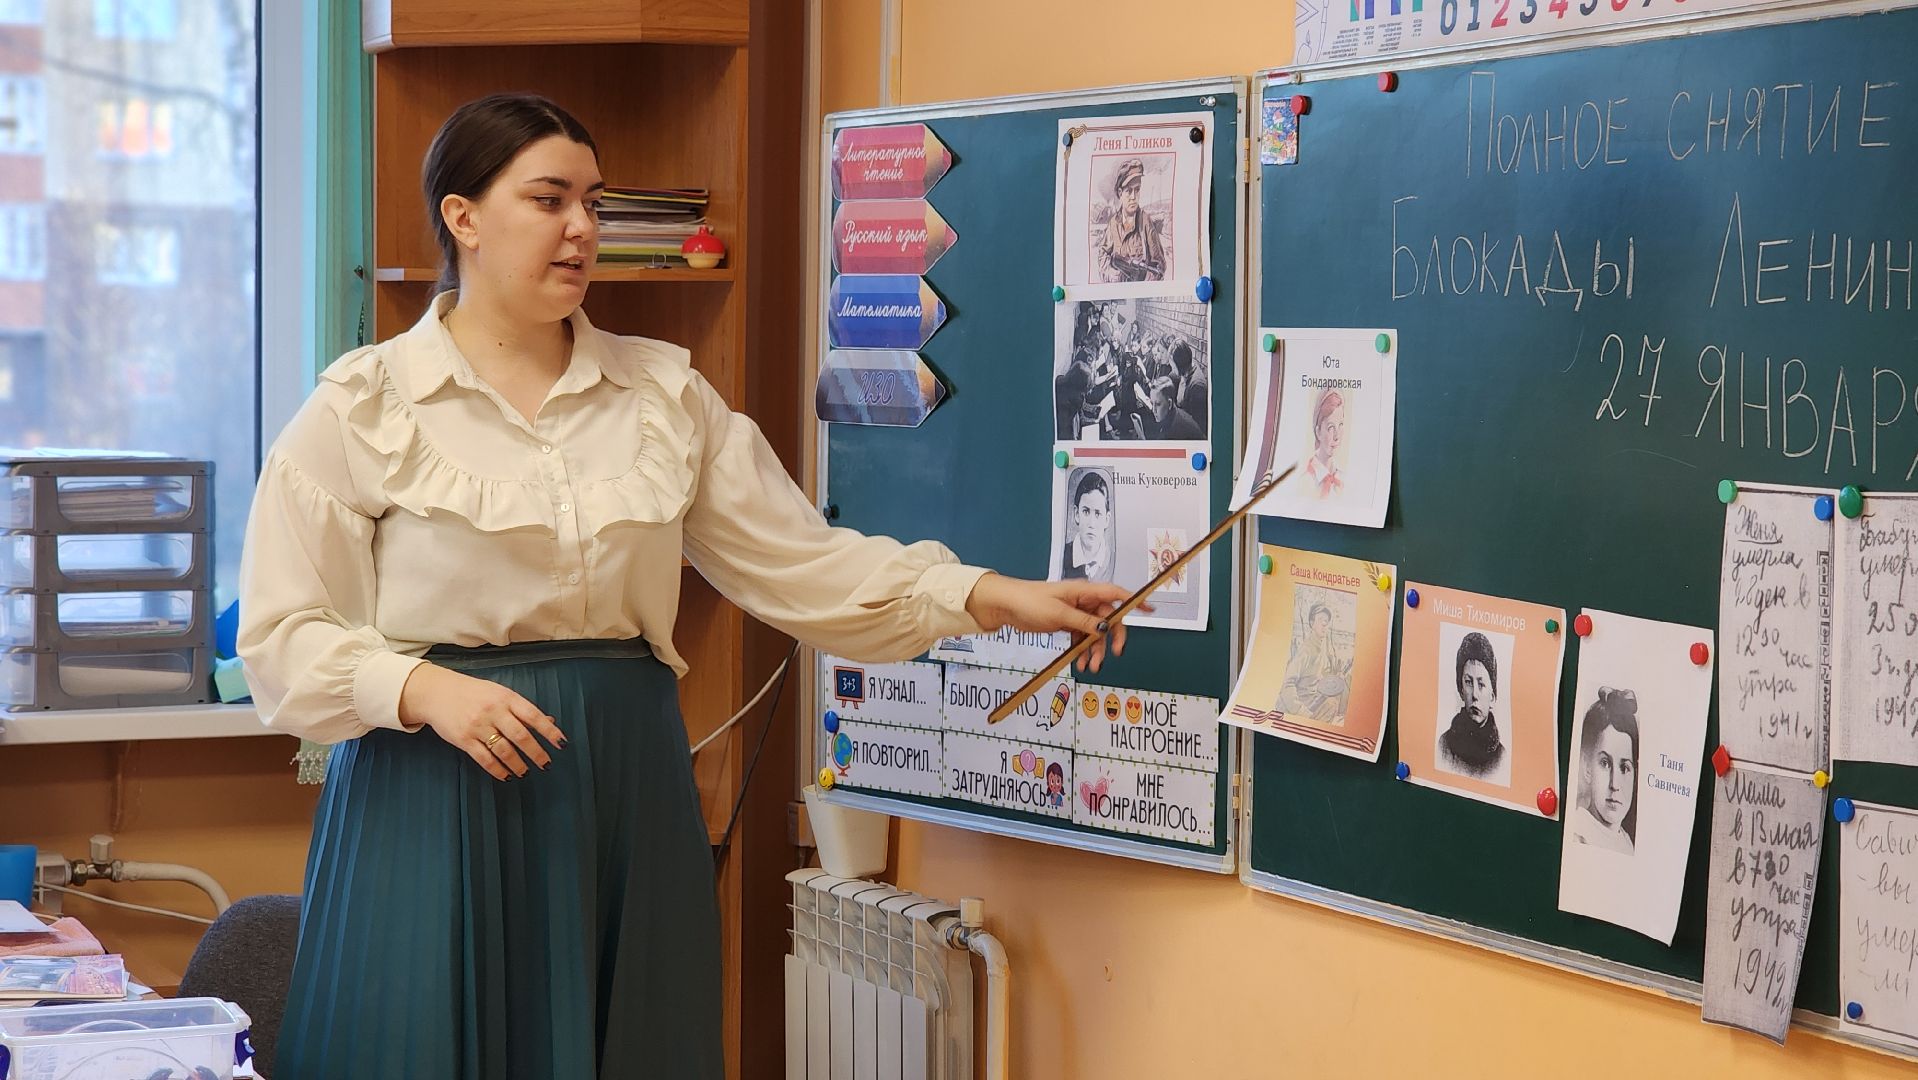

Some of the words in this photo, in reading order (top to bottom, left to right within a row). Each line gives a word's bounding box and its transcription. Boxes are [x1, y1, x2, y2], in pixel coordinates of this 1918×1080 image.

[1094, 136, 1121, 151] Леня
[1125, 135, 1172, 150] Голиков
[864, 168, 904, 181] чтение
[842, 220, 893, 252] Русский
[895, 227, 928, 252] язык
[837, 296, 922, 318] Математика
[1322, 355, 1340, 369] Юта
[857, 371, 895, 405] ИЗО
[1301, 374, 1361, 391] Бондаровская
[1595, 333, 1666, 427] 27
[1112, 472, 1136, 485] Нина
[1138, 472, 1197, 489] Куковерова
[1290, 563, 1311, 579] Саша
[1313, 567, 1361, 587] Кондратьев
[1433, 599, 1462, 617] Миша
[1467, 605, 1526, 631] Тихомиров
[869, 677, 876, 699] Я
[950, 682, 991, 710] БЫЛО
[1144, 699, 1177, 727] МОЁ
[852, 741, 859, 763] Я
[1001, 750, 1007, 774] Я
[1660, 753, 1684, 772] Таня
[1137, 772, 1164, 799] МНЕ
[1647, 773, 1691, 798] Савичева
